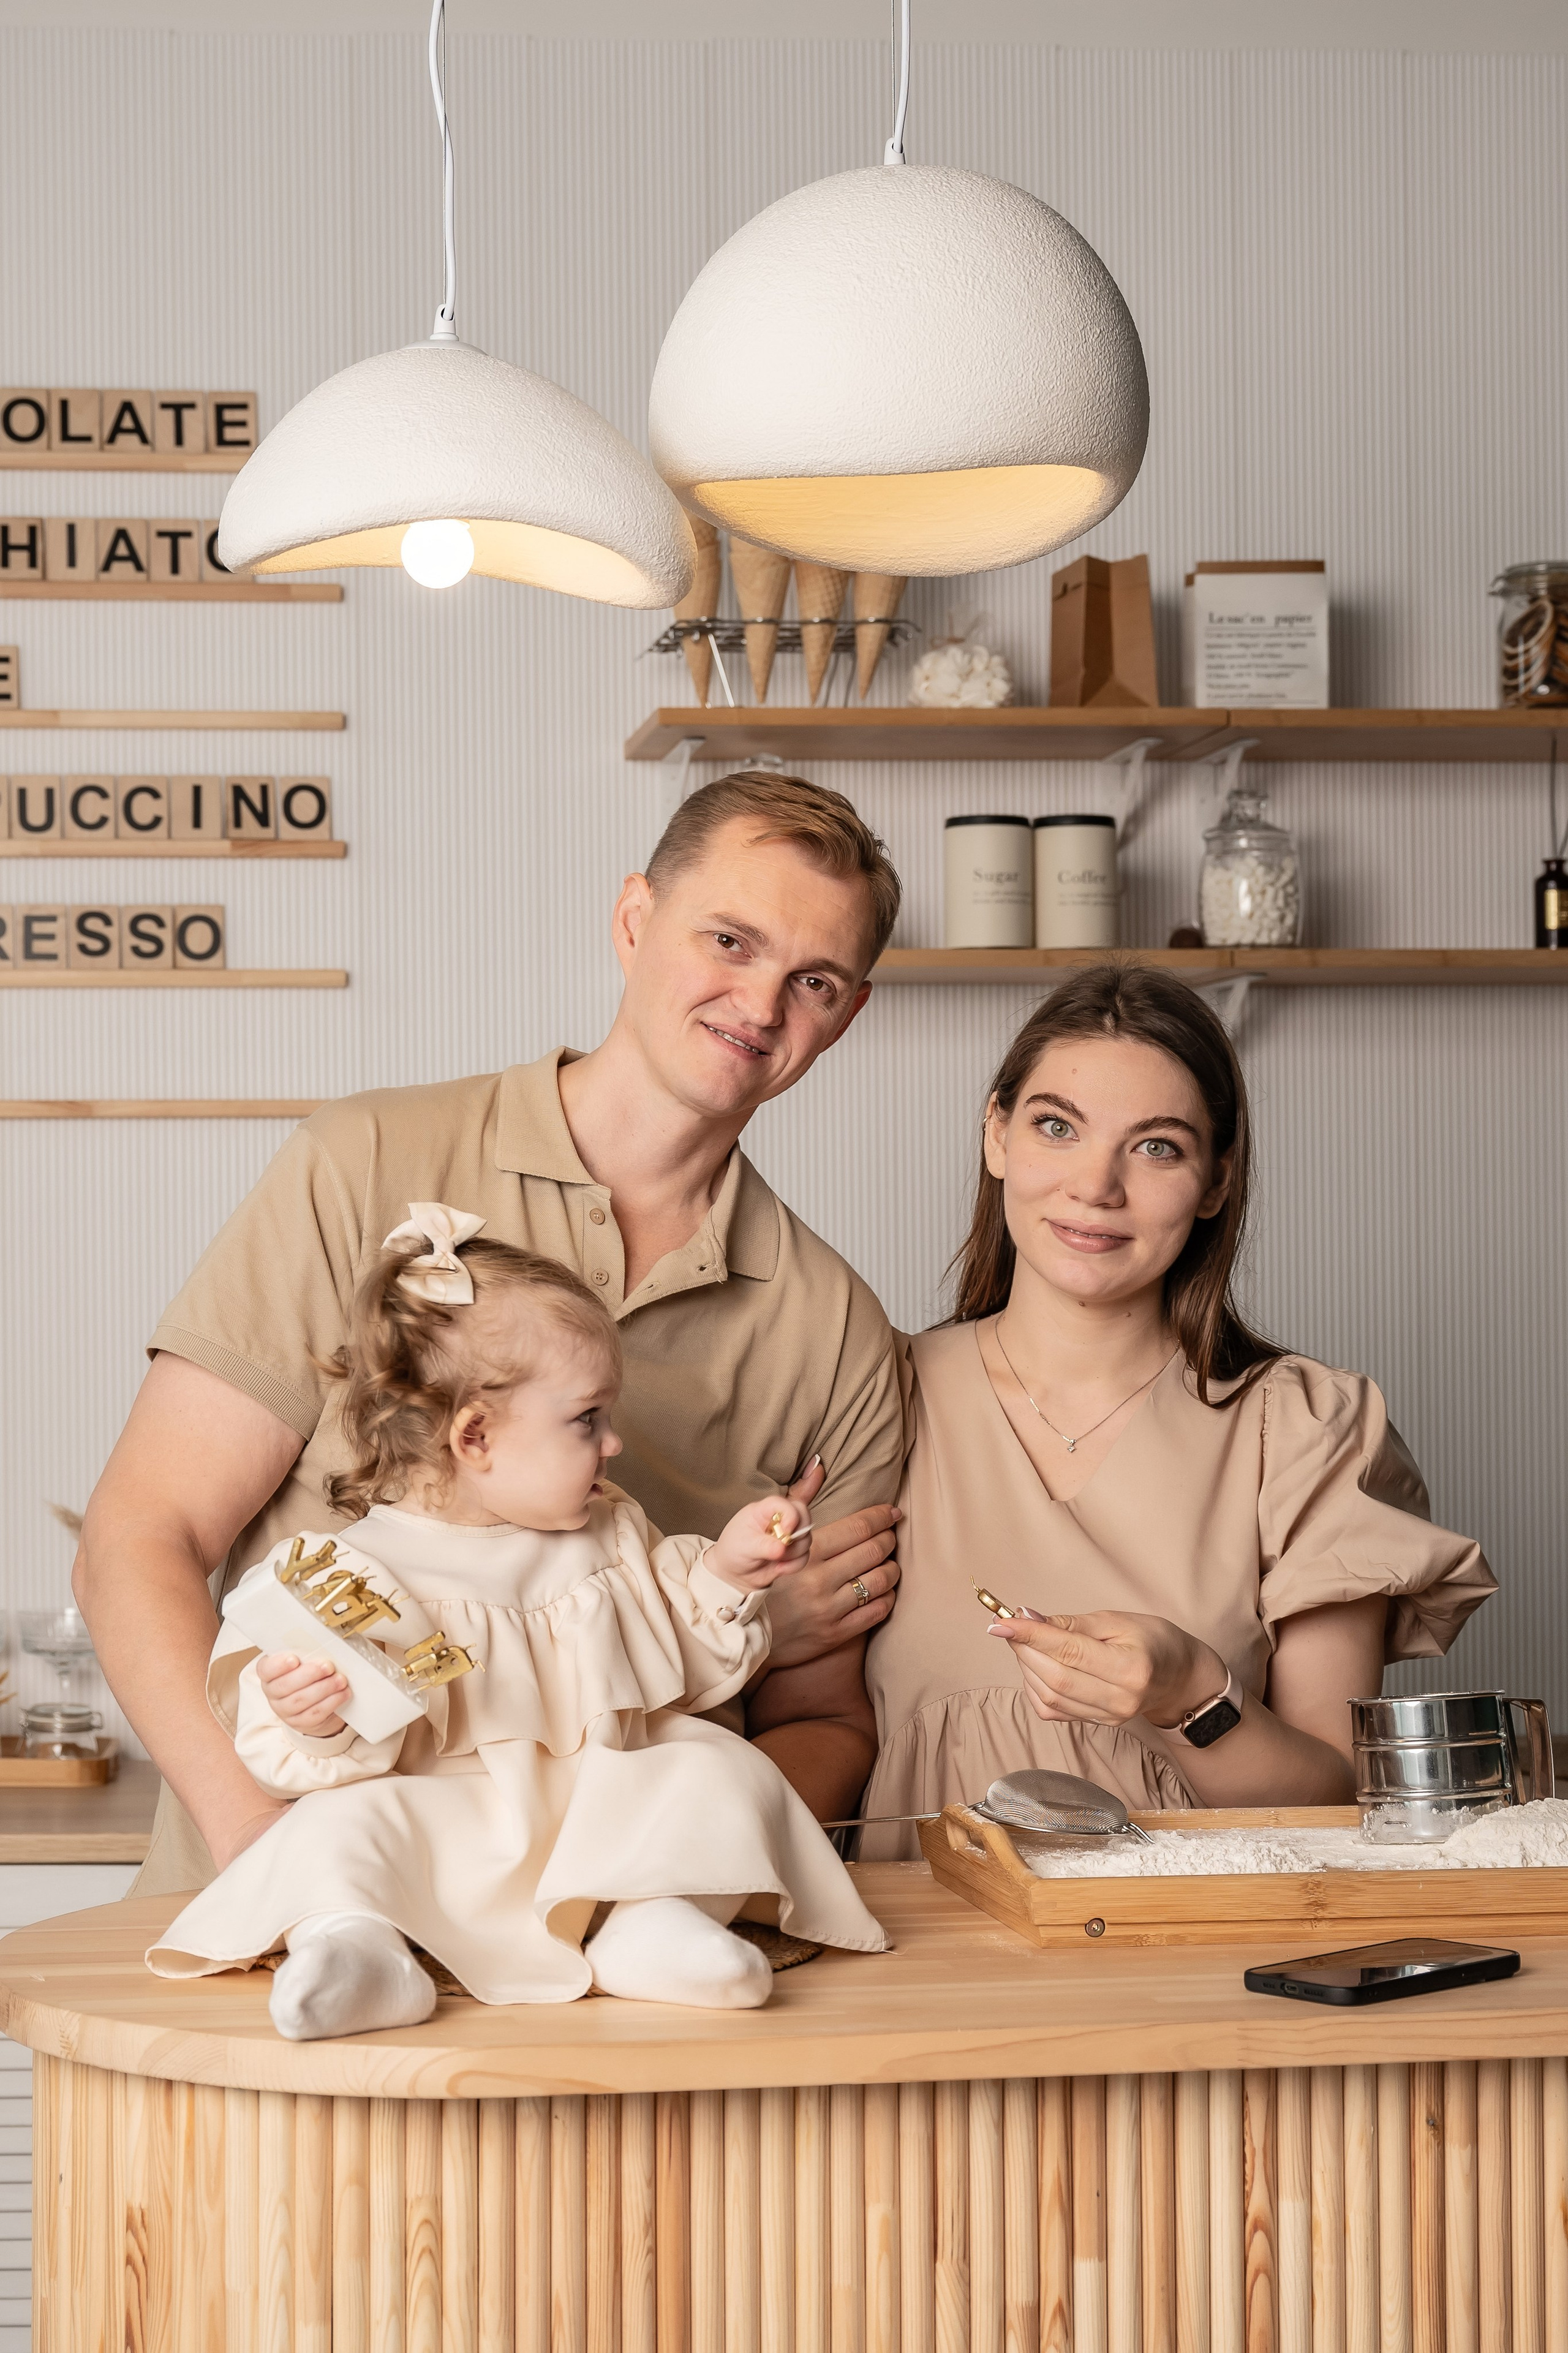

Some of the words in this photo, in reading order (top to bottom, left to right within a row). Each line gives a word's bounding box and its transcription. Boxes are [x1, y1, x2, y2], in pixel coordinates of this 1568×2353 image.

[2, 398, 252, 447] OLATE
[0, 783, 328, 833] UCCINO
[973, 867, 1019, 886] Sugar
[0, 910, 222, 961] ESSO
